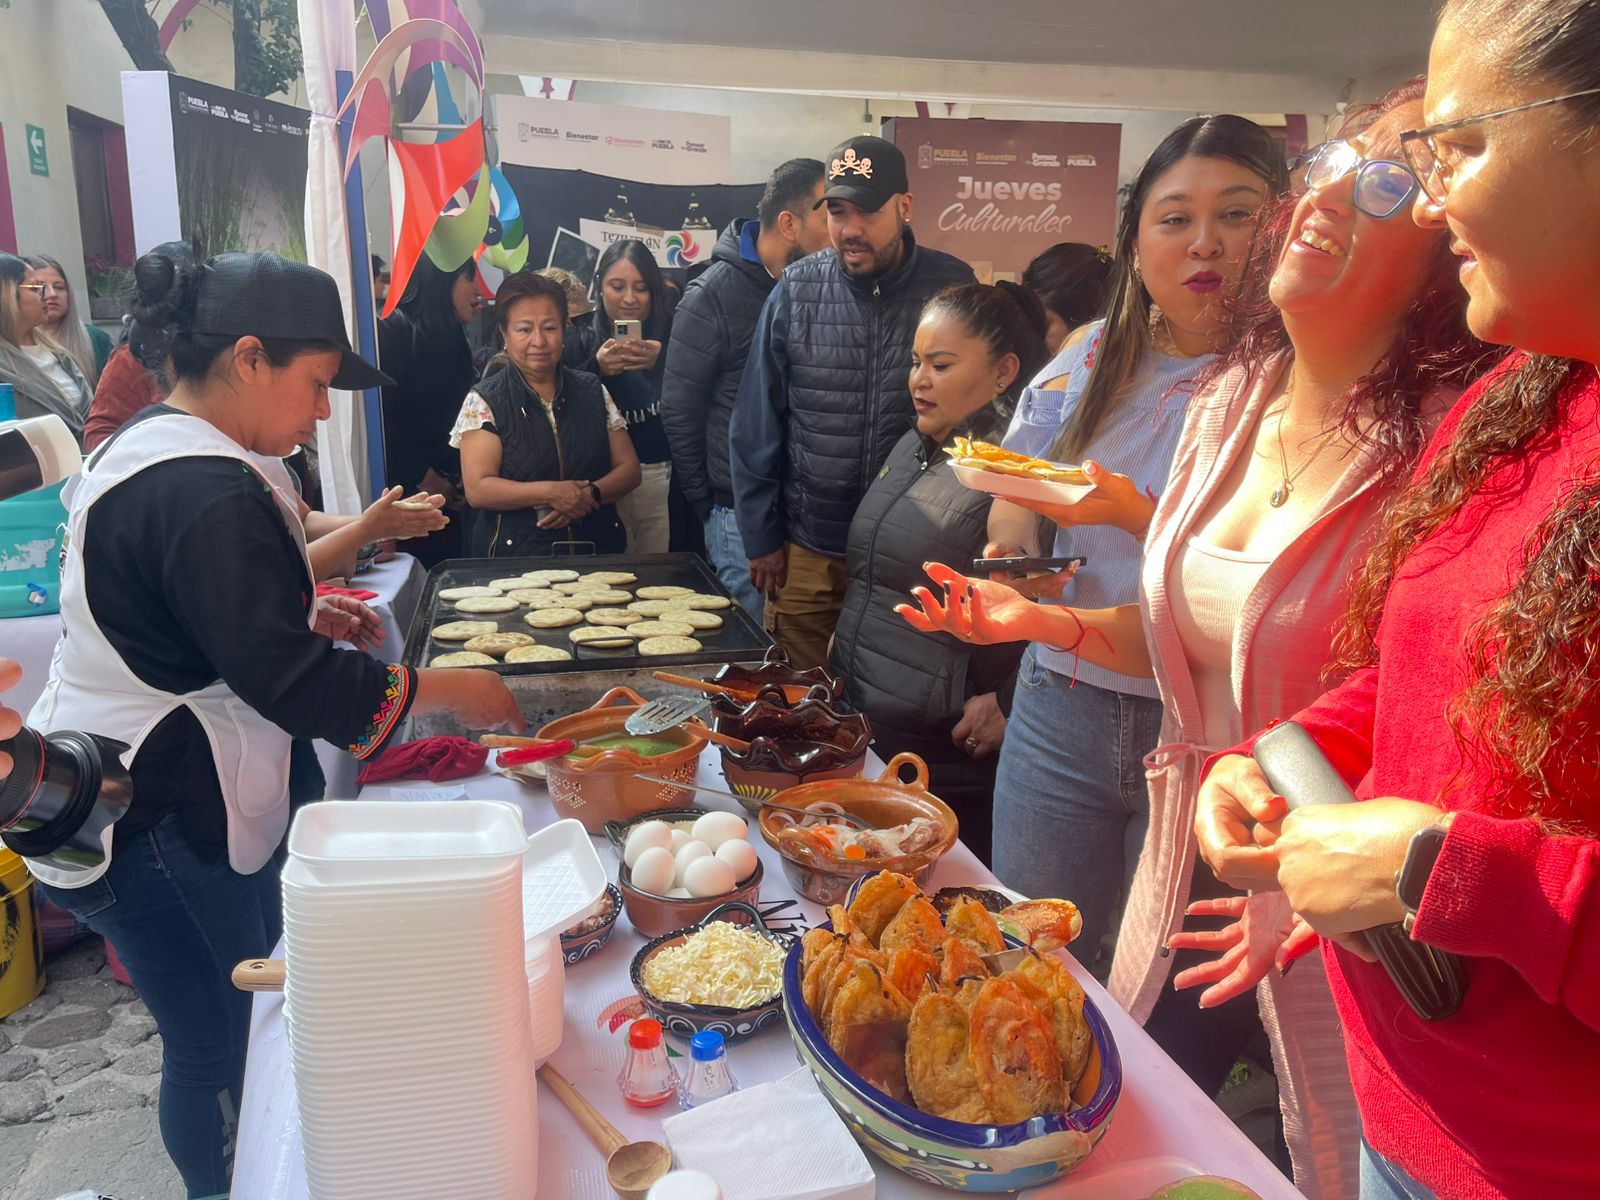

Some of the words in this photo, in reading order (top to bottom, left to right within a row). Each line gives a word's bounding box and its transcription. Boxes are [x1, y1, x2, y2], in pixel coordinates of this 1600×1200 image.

[187, 96, 209, 108] PUEBLA
[211, 108, 229, 119] PUEBLA
[530, 126, 559, 135] PUEBLA
[566, 131, 599, 141] Bienestar
[933, 149, 968, 158] PUEBLA
[976, 152, 1017, 161] Bienestar
[955, 176, 1062, 201] Jueves
[938, 202, 1073, 234] Culturales
